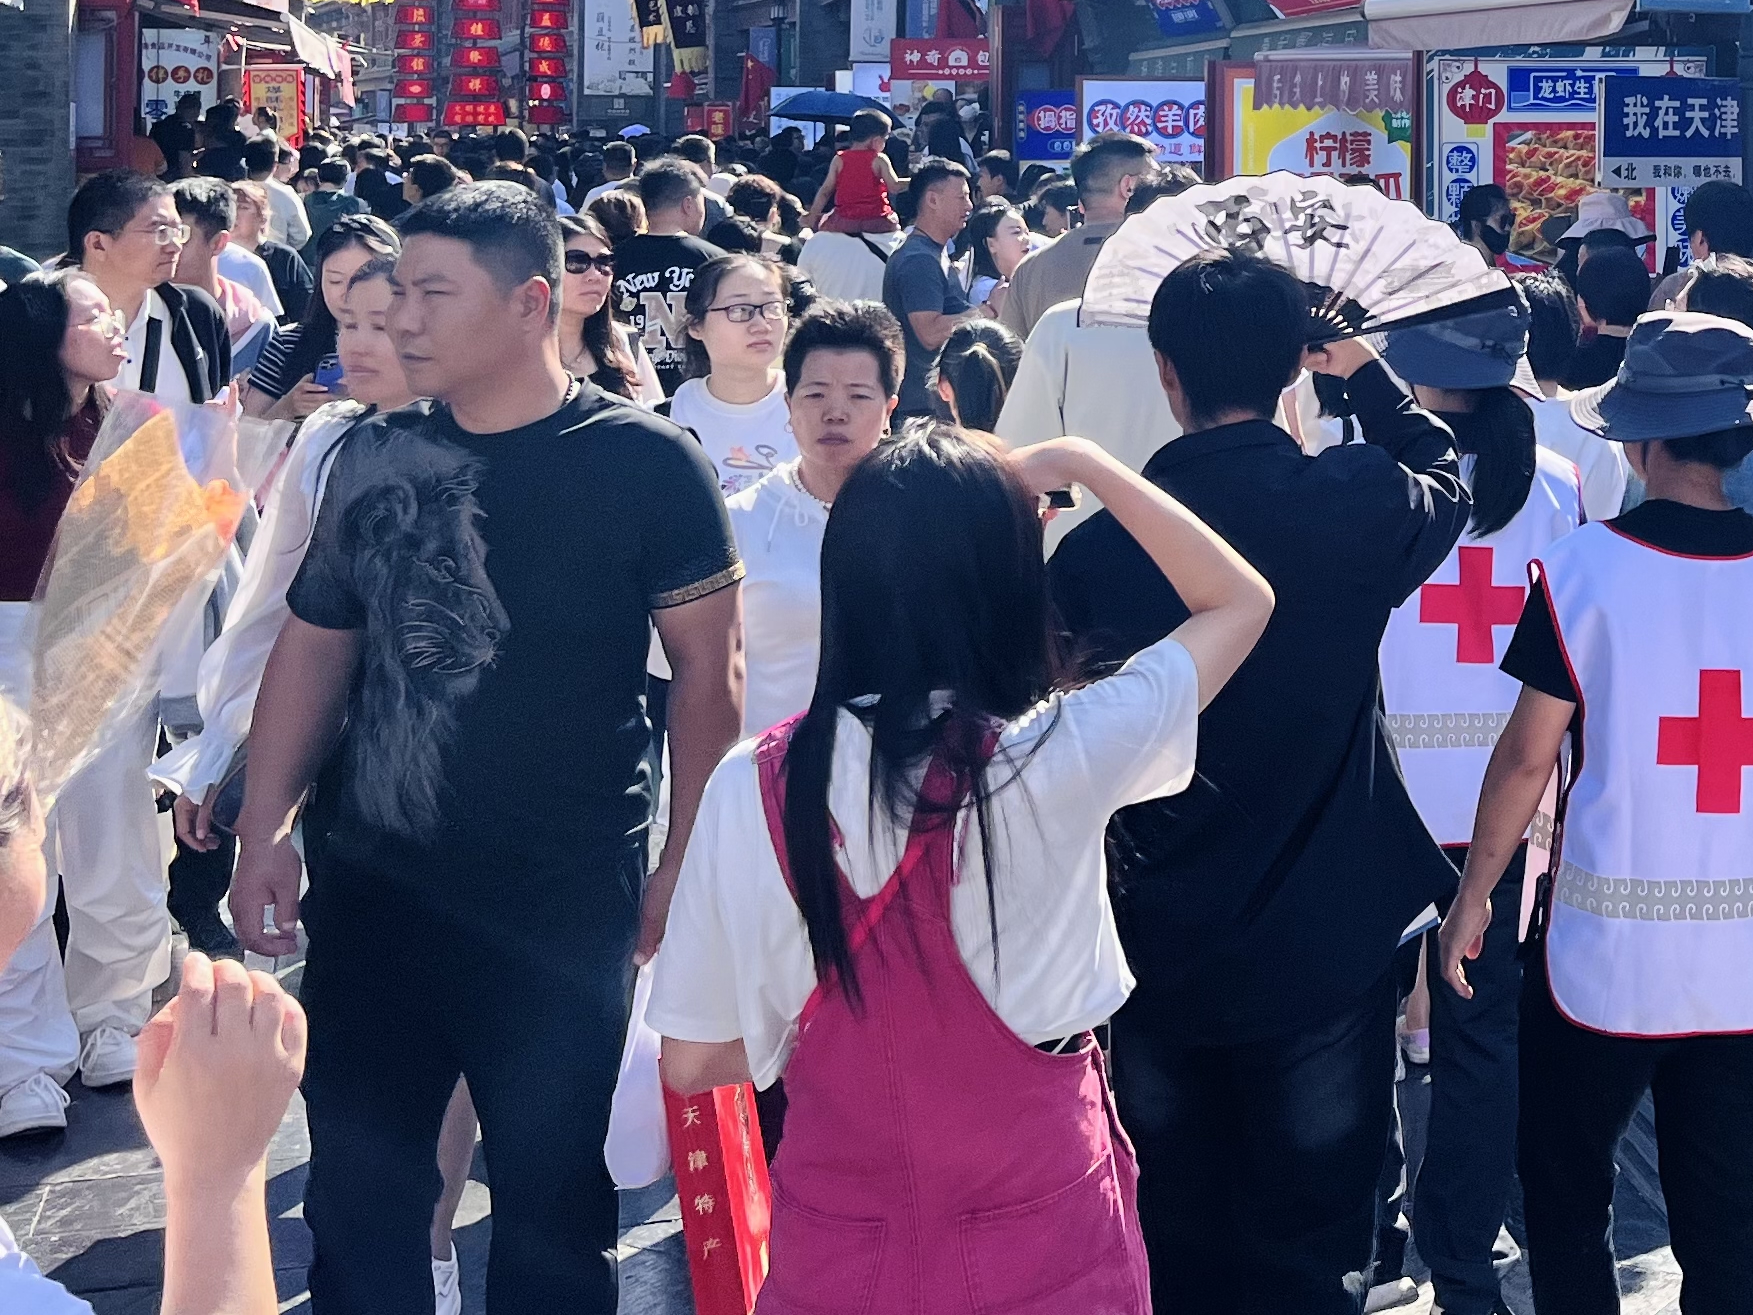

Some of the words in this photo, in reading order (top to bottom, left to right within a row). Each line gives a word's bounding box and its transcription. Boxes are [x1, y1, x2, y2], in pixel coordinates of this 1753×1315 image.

[1272, 70, 1404, 104] 舌尖上的美味
[1456, 84, 1496, 112] 津门
[1538, 79, 1597, 99] 龙虾生
[1623, 94, 1740, 139] 我在天津
[1305, 131, 1372, 168] 柠檬
[1624, 162, 1637, 181] 北
[616, 271, 660, 298] New
[682, 1105, 722, 1262] 天津特产
